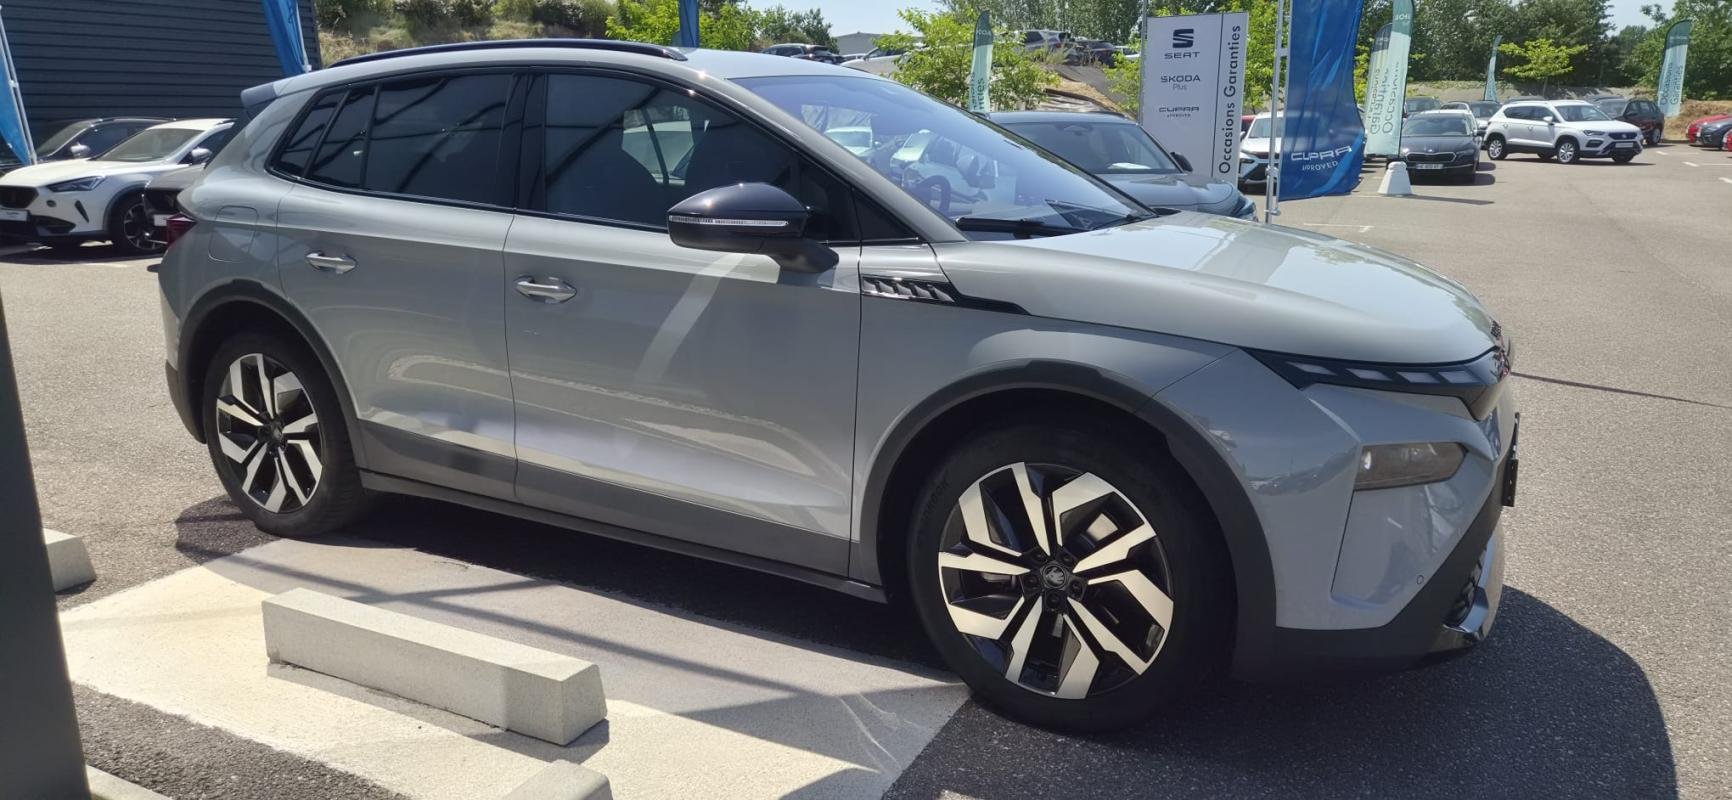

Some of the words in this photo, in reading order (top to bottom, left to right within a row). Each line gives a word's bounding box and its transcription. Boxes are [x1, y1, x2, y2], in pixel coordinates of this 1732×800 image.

[1164, 51, 1200, 60] SEAT
[1223, 25, 1241, 98] Garanties
[1172, 83, 1188, 91] Plus
[1218, 101, 1236, 174] Occasions
[1290, 145, 1353, 161] CUPRA
